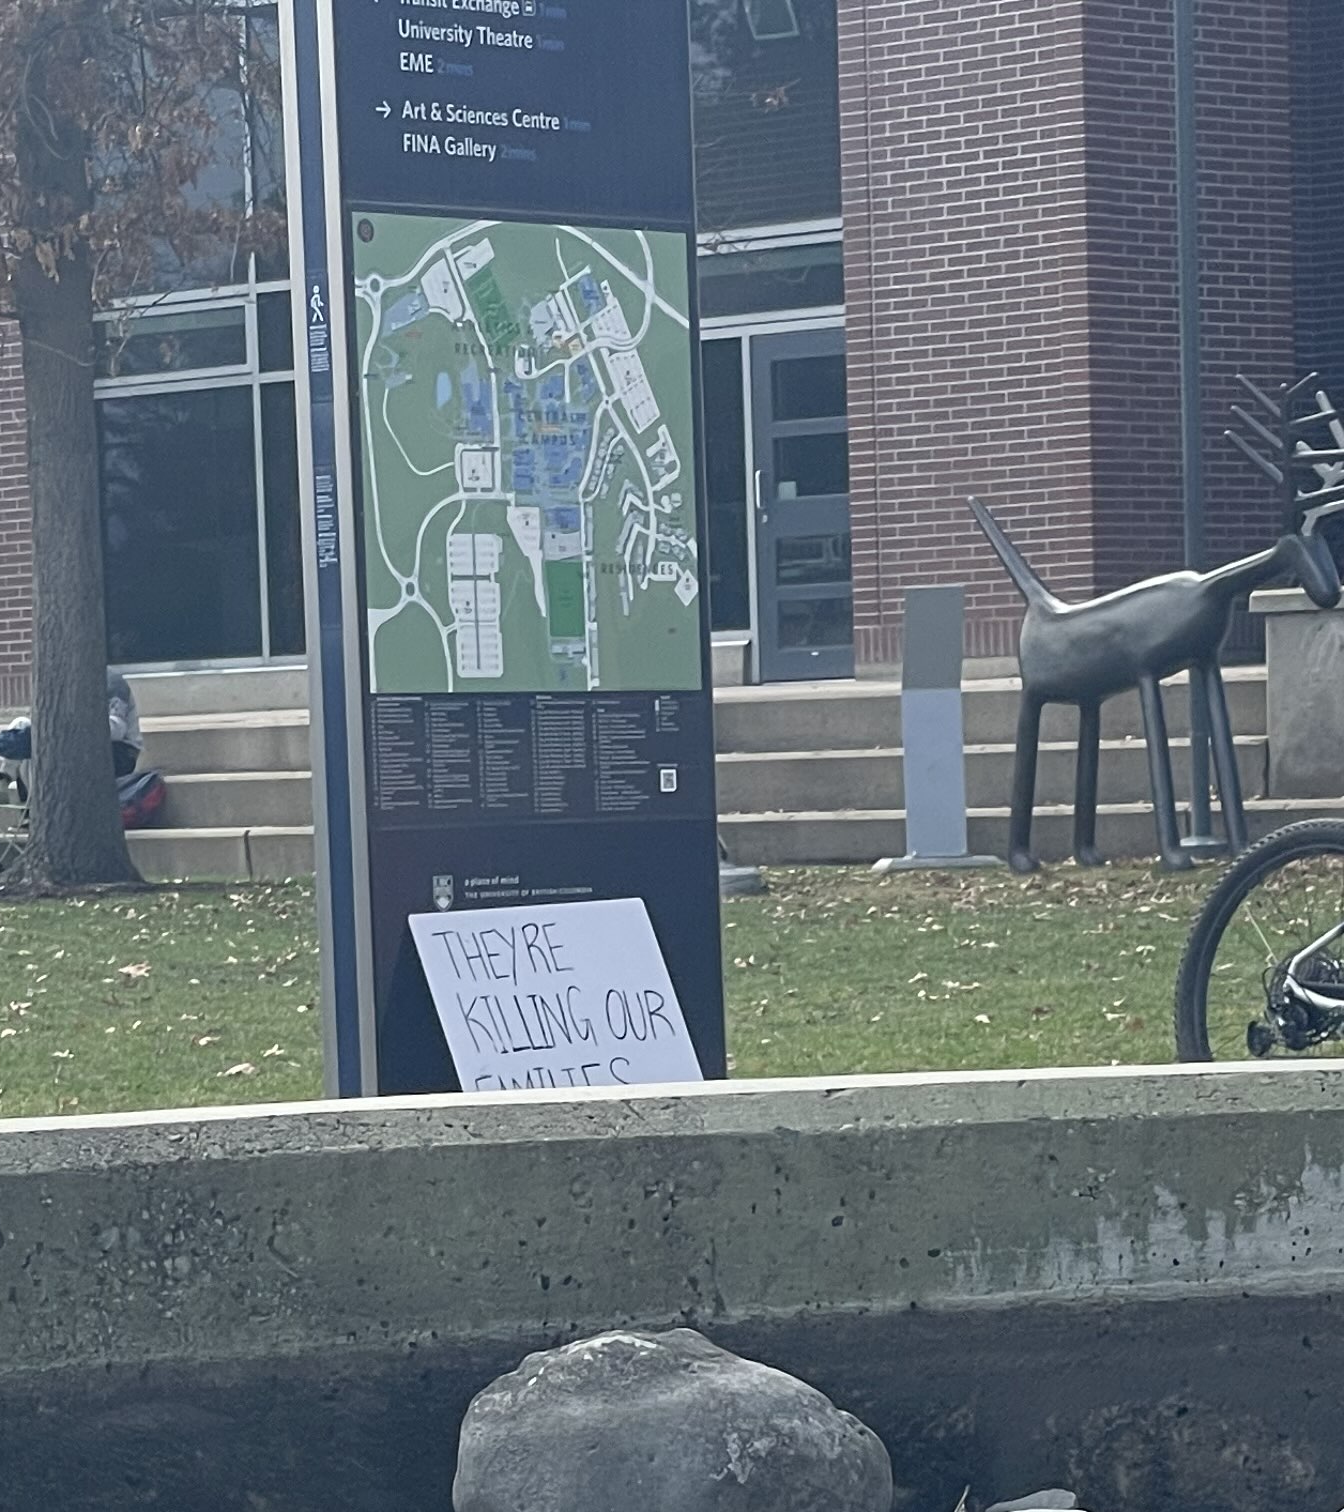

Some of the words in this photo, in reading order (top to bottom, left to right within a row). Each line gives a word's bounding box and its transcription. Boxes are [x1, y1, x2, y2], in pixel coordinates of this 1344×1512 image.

[398, 18, 473, 47] University
[476, 26, 533, 49] Theatre
[399, 52, 434, 73] EME
[402, 100, 427, 121] Art
[430, 102, 442, 121] &
[446, 104, 508, 127] Sciences
[512, 109, 560, 130] Centre
[403, 133, 441, 154] FINA
[444, 136, 497, 162] Gallery
[456, 986, 598, 1054] KILLING
[606, 989, 676, 1041] OUR
